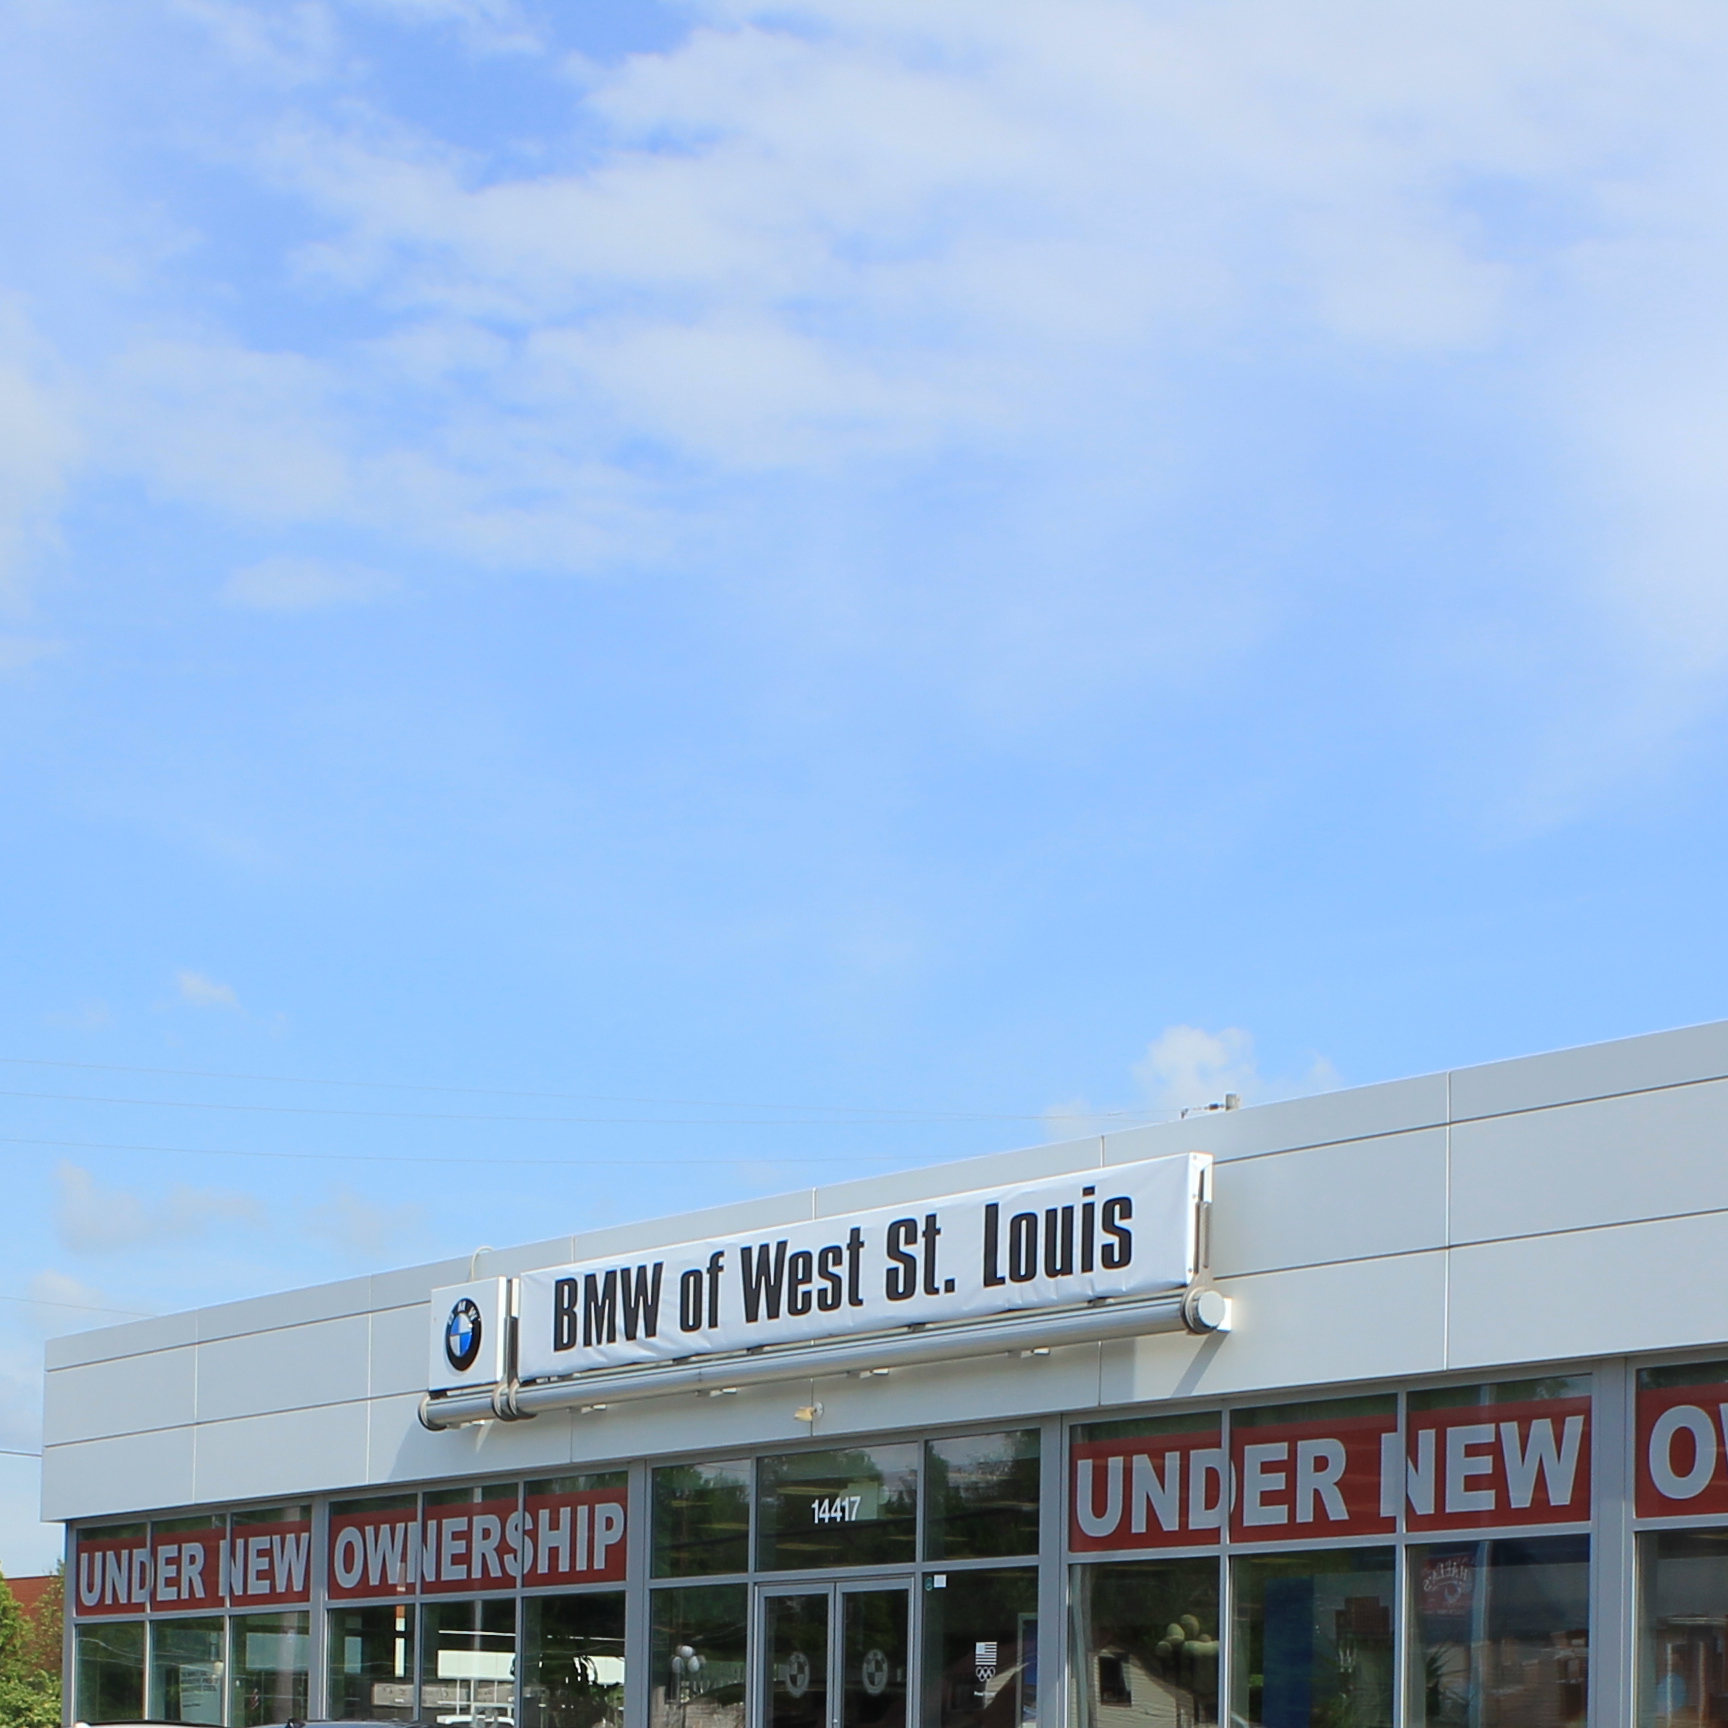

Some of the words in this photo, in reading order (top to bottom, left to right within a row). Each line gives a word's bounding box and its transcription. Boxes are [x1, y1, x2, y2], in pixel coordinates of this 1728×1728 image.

[554, 1261, 664, 1353] BMW
[679, 1250, 725, 1333] of
[740, 1226, 865, 1324] West
[885, 1213, 956, 1302] St.
[982, 1186, 1133, 1288] Louis
[811, 1496, 861, 1524] 14417
[1076, 1437, 1350, 1538] UNDER
[1380, 1415, 1585, 1518] NEW
[79, 1542, 206, 1607] UNDER
[219, 1532, 310, 1596] NEW
[333, 1502, 625, 1588] OWNERSHIP
